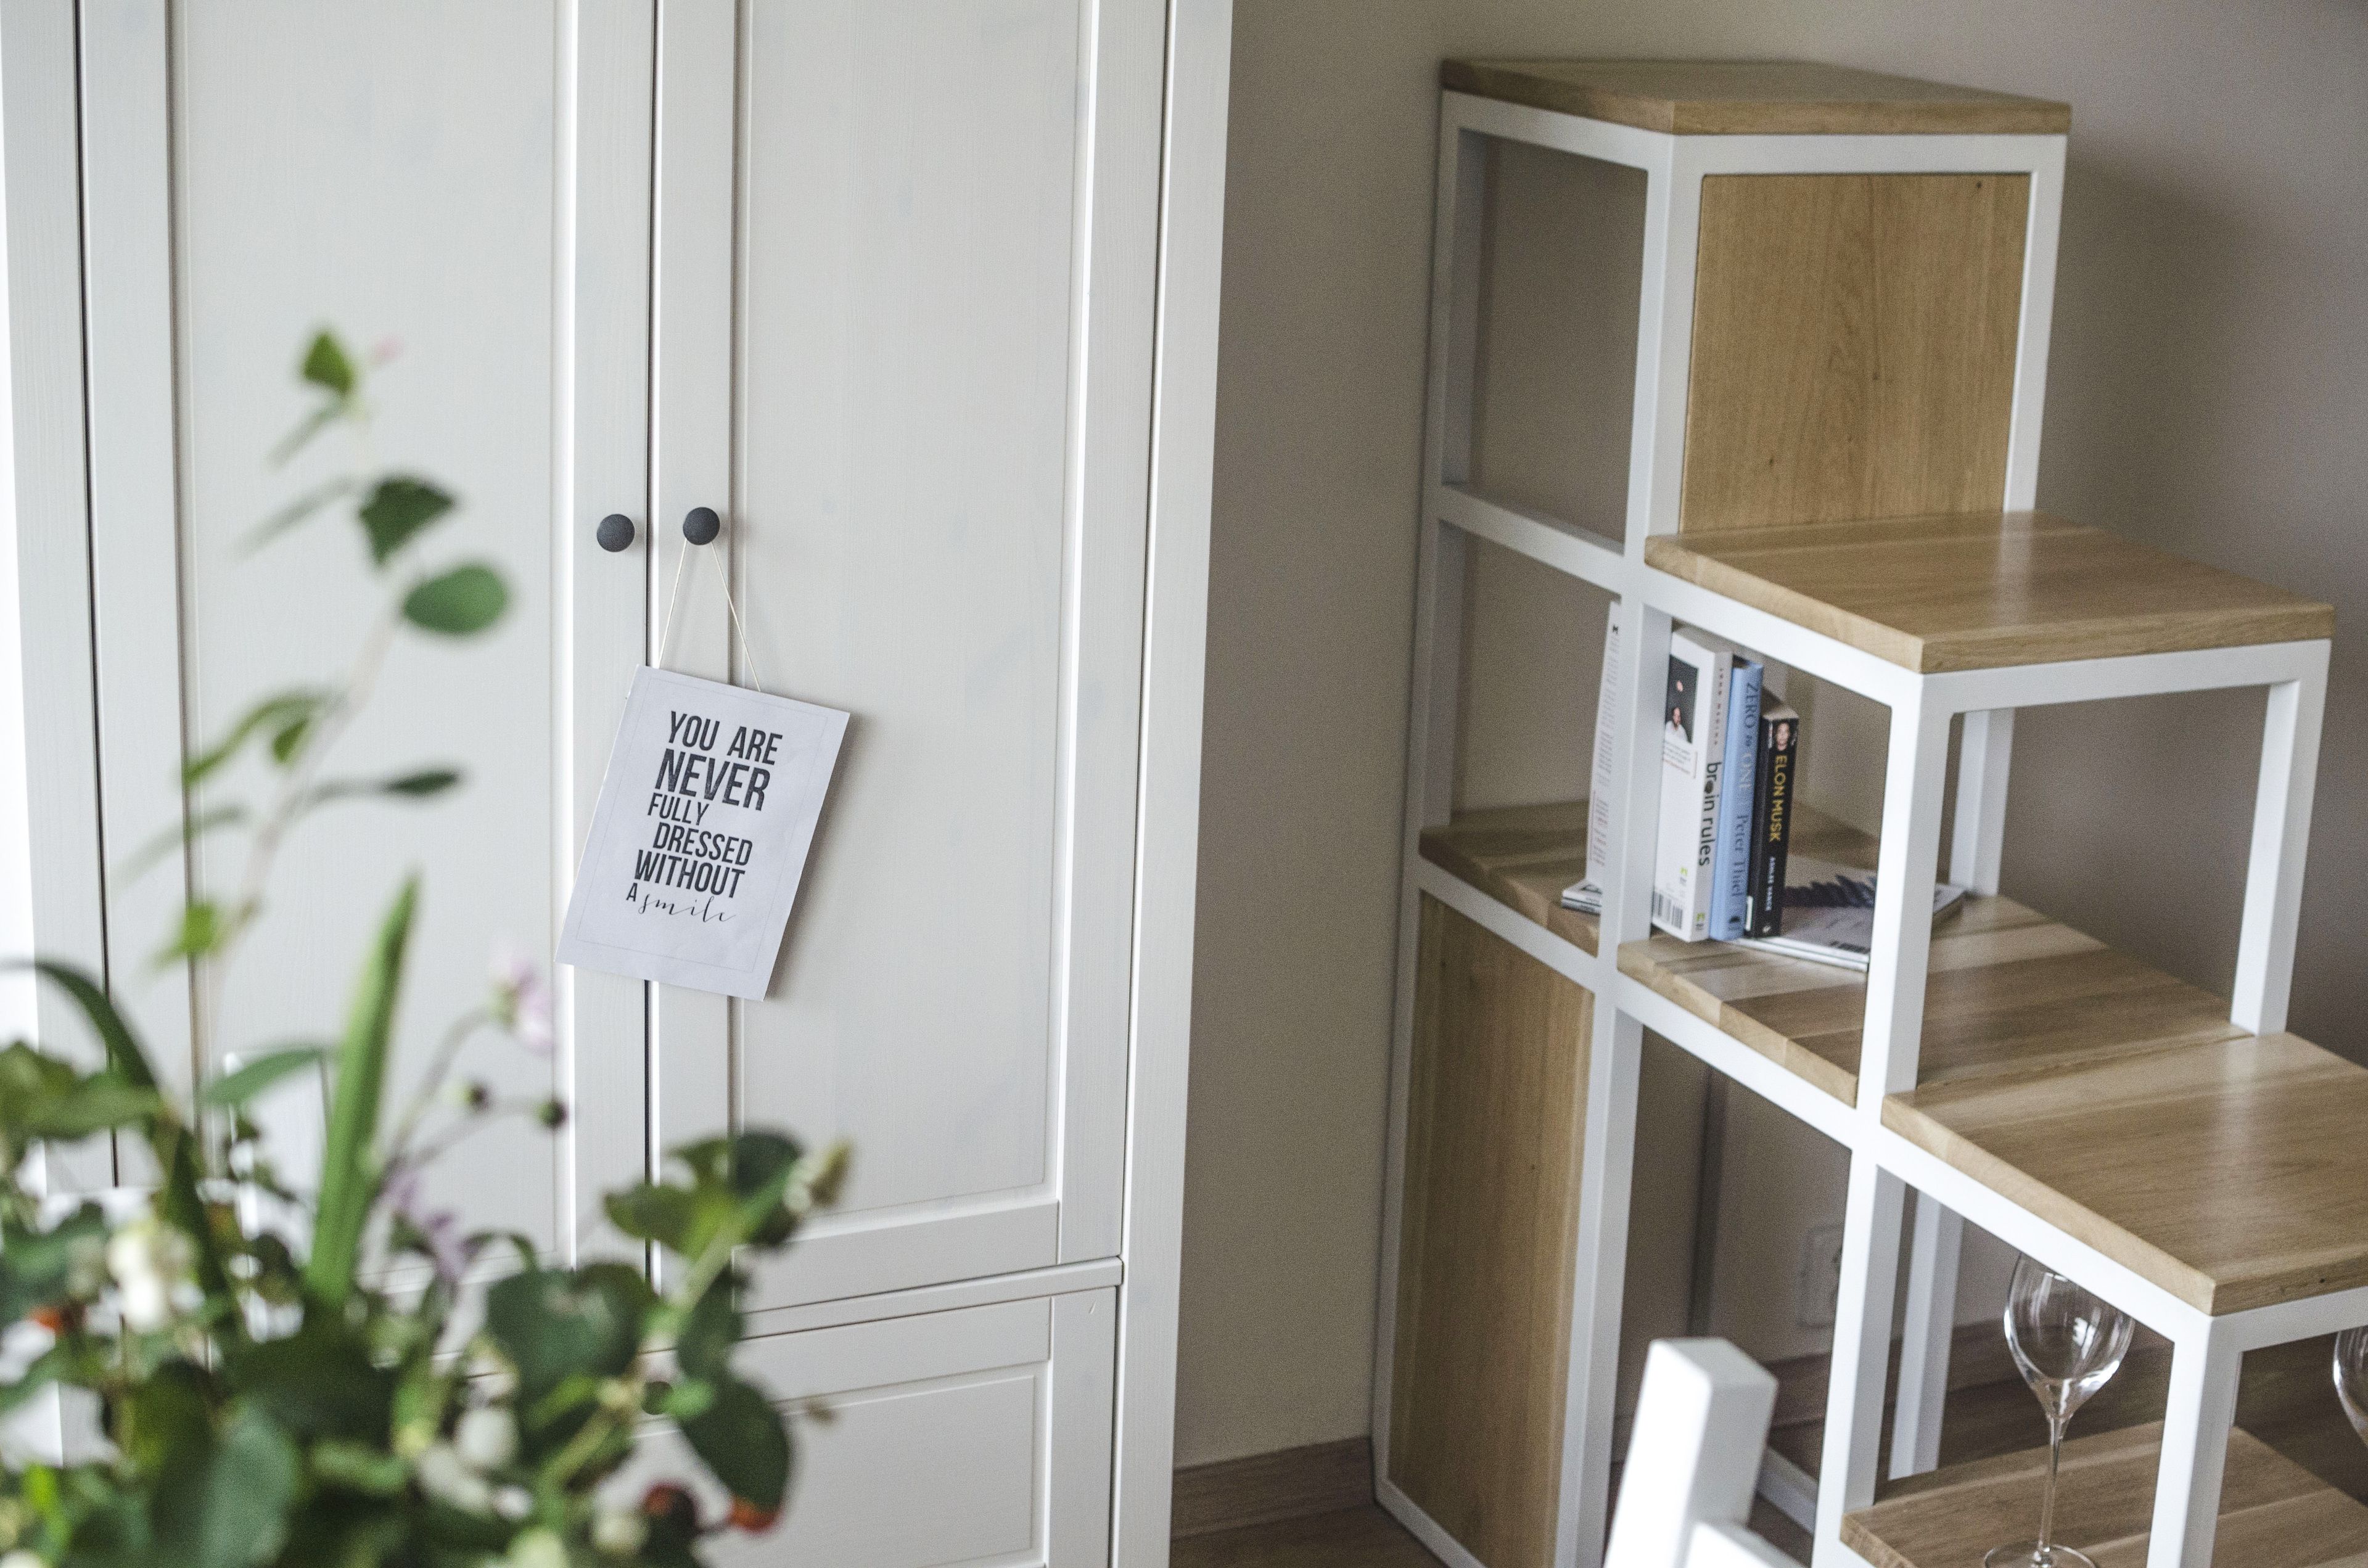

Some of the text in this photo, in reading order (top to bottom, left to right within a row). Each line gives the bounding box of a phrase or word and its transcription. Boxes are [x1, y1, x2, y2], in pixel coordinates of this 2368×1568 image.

[1745, 682, 1759, 728] ZERO
[668, 710, 783, 766] YOU ARE
[654, 748, 771, 812] NEVER
[1769, 754, 1788, 842] ELON MUSK
[647, 792, 709, 826] FULLY
[652, 821, 753, 867] DRESSED
[1698, 817, 1716, 866] rules
[633, 849, 746, 899] WITHOUT
[625, 882, 737, 923] A smile
